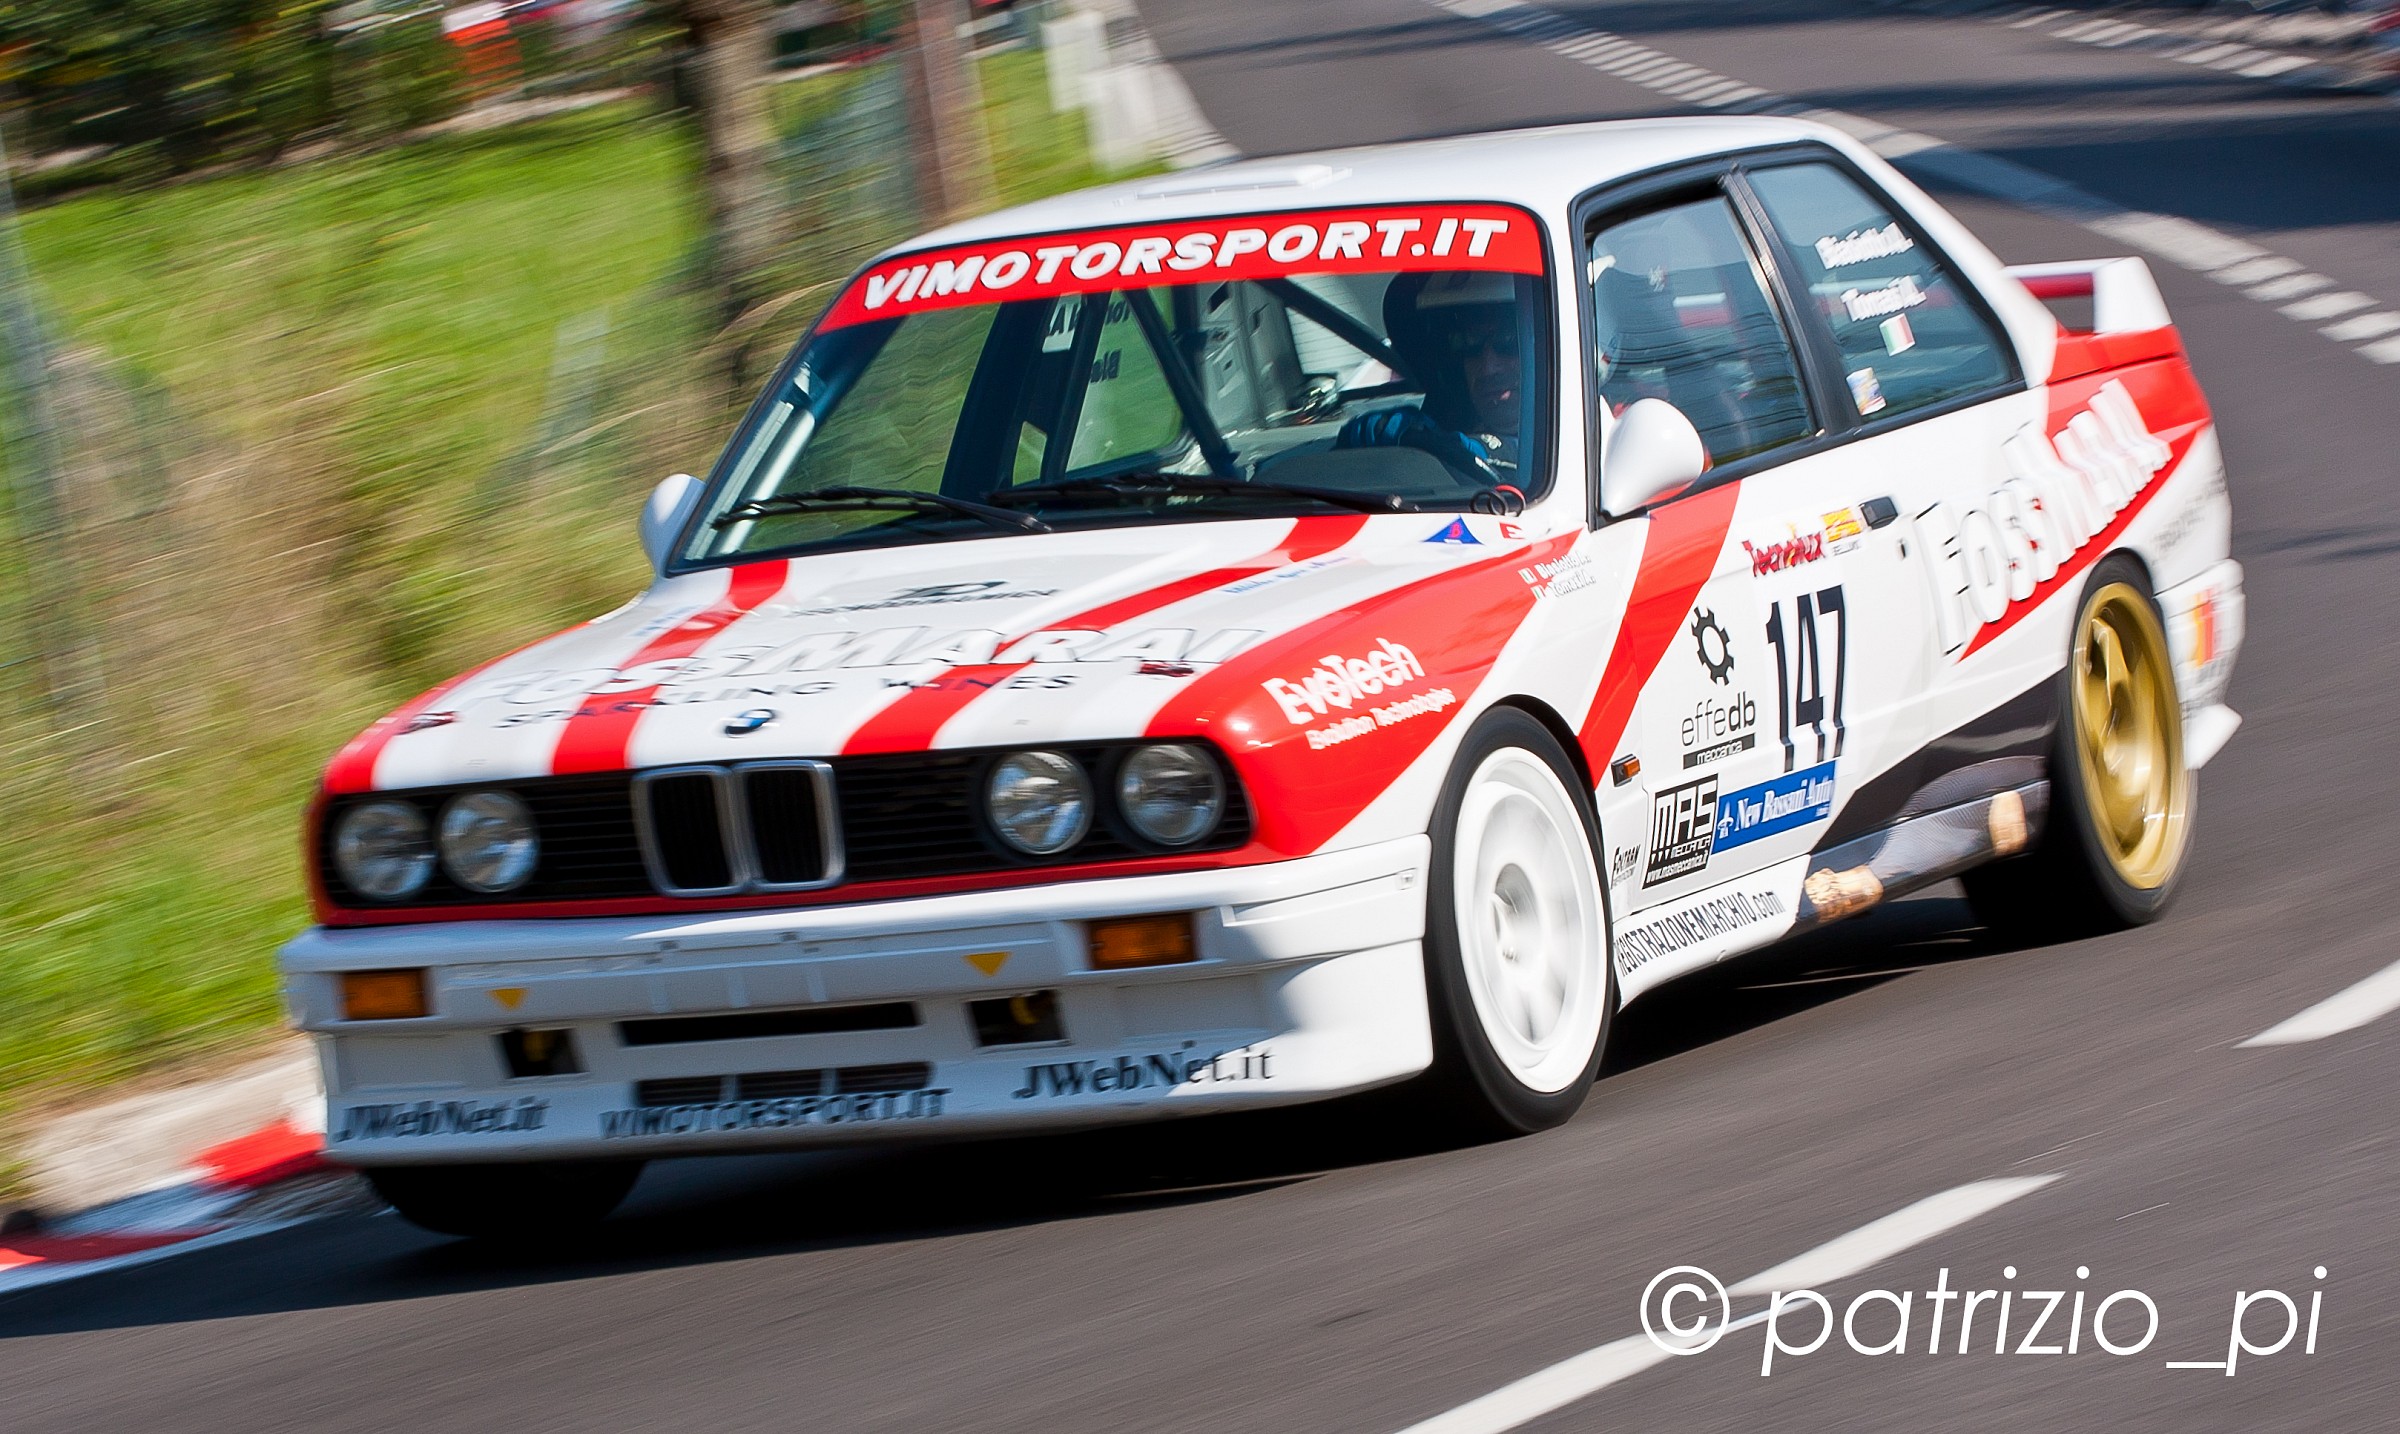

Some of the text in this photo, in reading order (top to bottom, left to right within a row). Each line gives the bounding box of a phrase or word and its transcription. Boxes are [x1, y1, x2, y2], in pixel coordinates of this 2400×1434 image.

[864, 217, 1510, 311] VIMOTORSPORT.IT
[1766, 583, 1847, 773] 147
[1681, 690, 1756, 747] effedb
[1652, 779, 1718, 852] MAS
[1011, 1046, 1276, 1099] JWebNet.it
